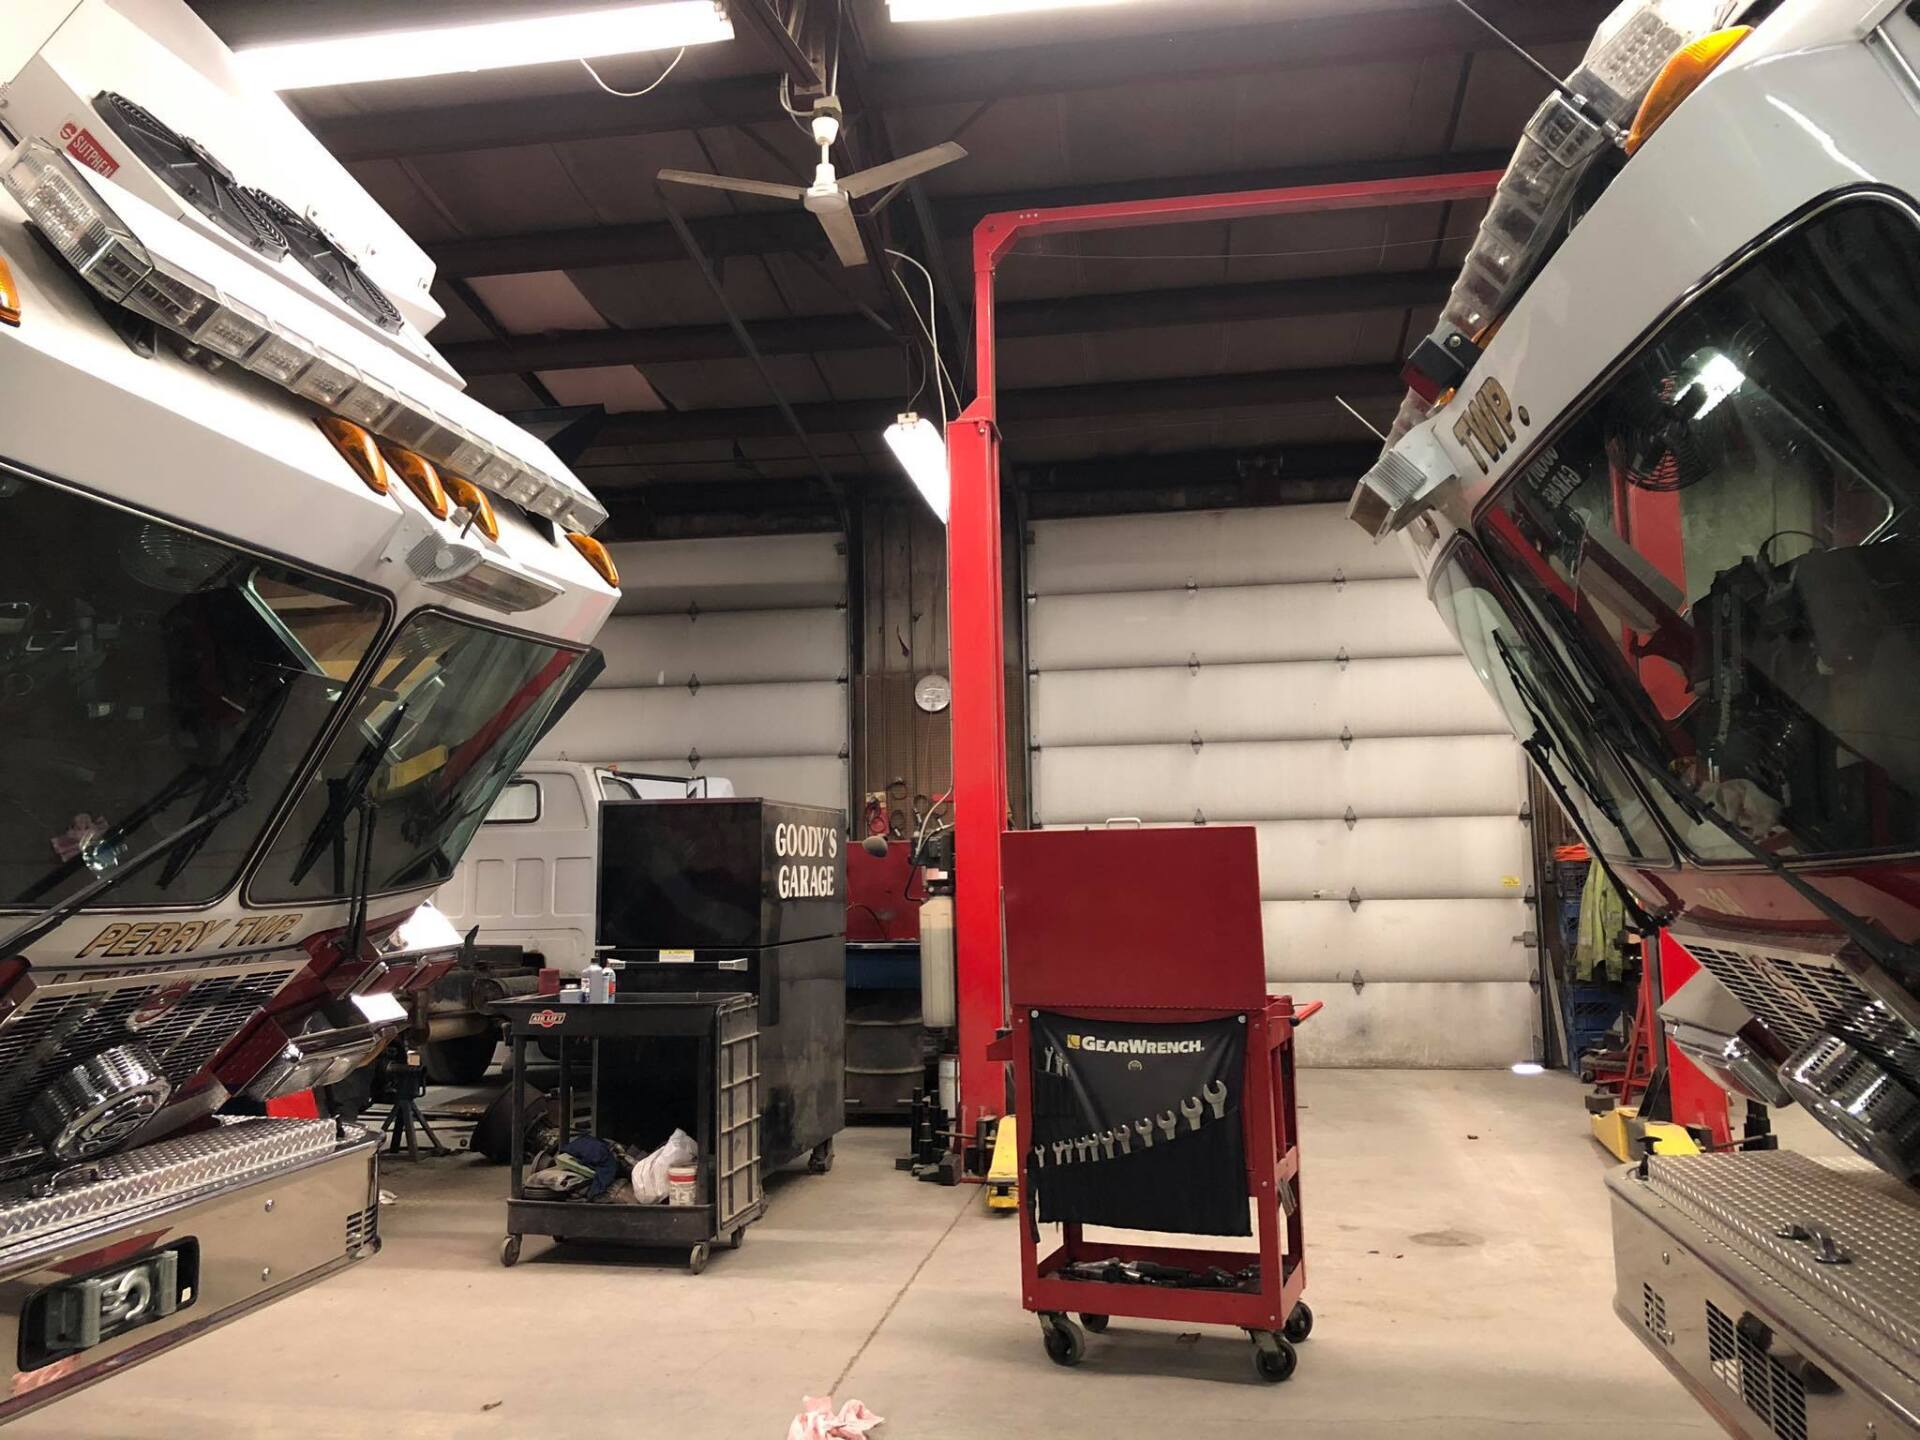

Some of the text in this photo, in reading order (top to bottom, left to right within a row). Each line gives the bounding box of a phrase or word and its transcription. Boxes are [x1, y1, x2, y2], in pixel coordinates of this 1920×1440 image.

[73, 135, 114, 178] SUTPHEN
[1453, 376, 1530, 475] TWP.
[775, 822, 838, 859] GOODY'S
[778, 865, 835, 899] GARAGE
[75, 913, 303, 959] PERRY TWP.
